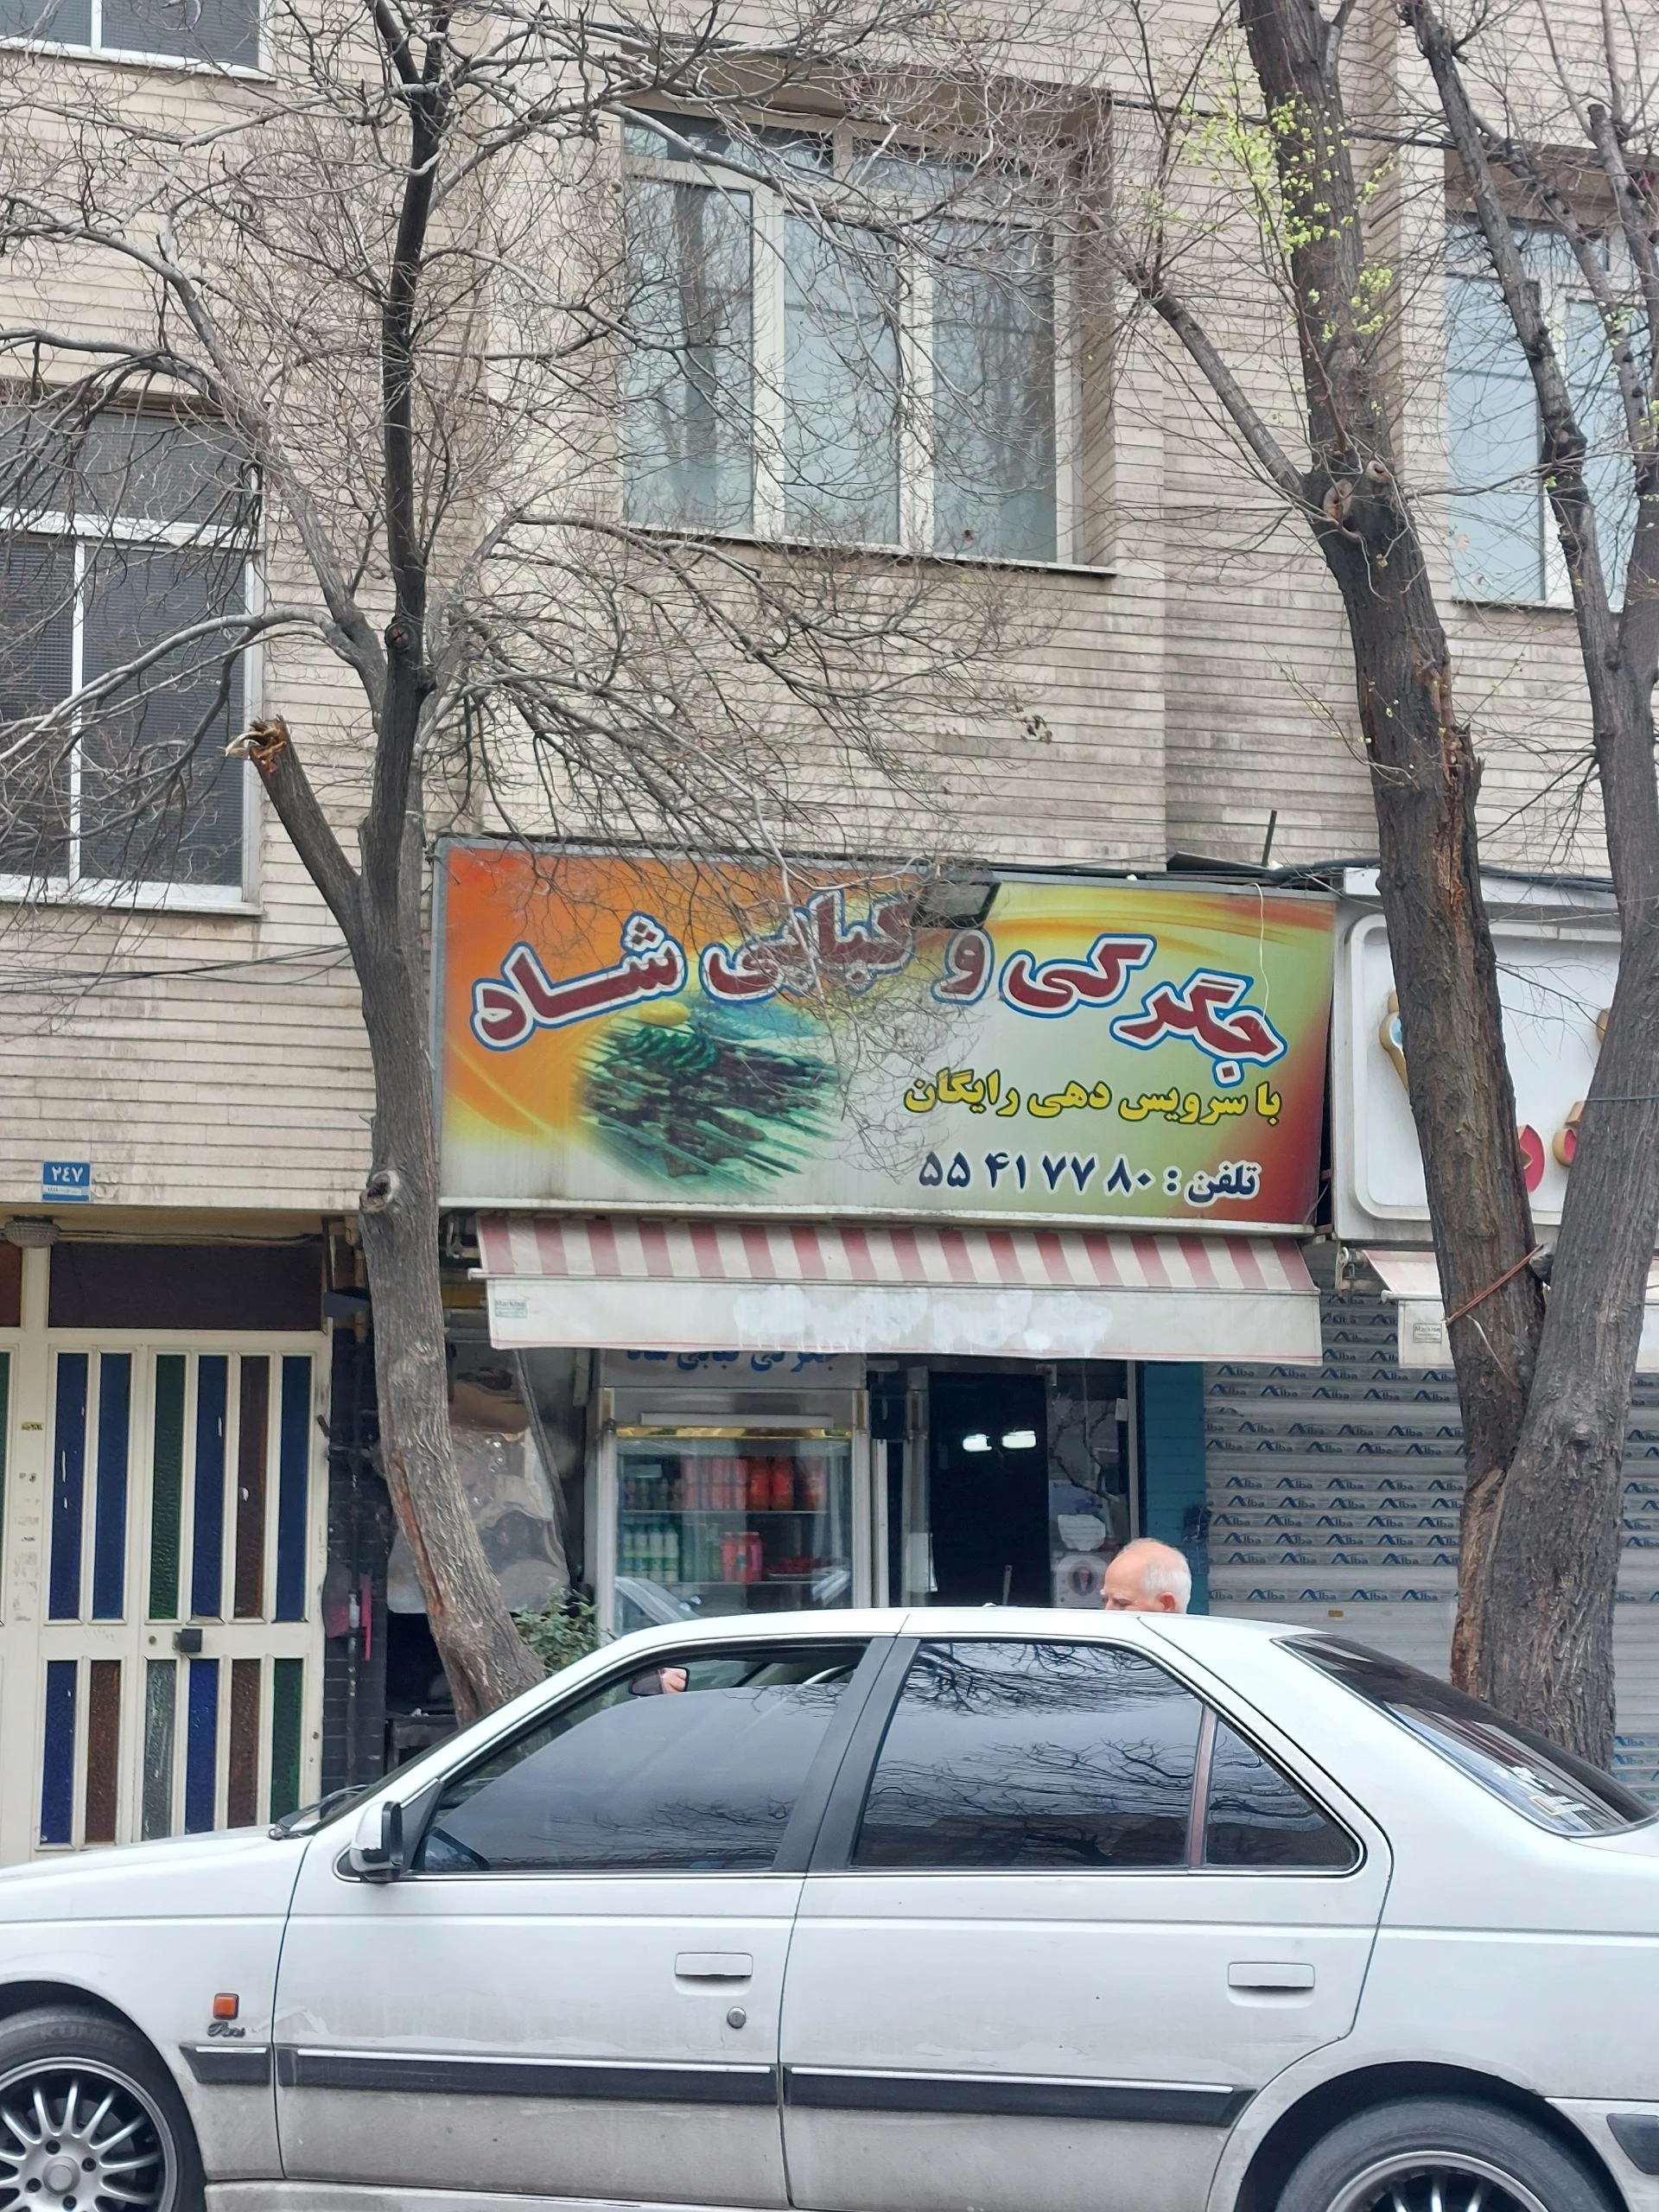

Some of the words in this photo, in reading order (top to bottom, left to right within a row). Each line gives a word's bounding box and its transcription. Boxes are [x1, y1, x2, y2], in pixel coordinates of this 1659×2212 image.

[471, 911, 687, 1052] شاد
[931, 929, 995, 1005] و
[904, 1066, 1020, 1117] رایگان
[1027, 1080, 1112, 1117] دهی
[1118, 1087, 1249, 1126] سرویس
[1255, 1082, 1282, 1125] با
[1369, 1351, 1398, 1362] Alb
[1436, 1426, 1464, 1437] Alb
[1431, 1498, 1461, 1509] Alb
